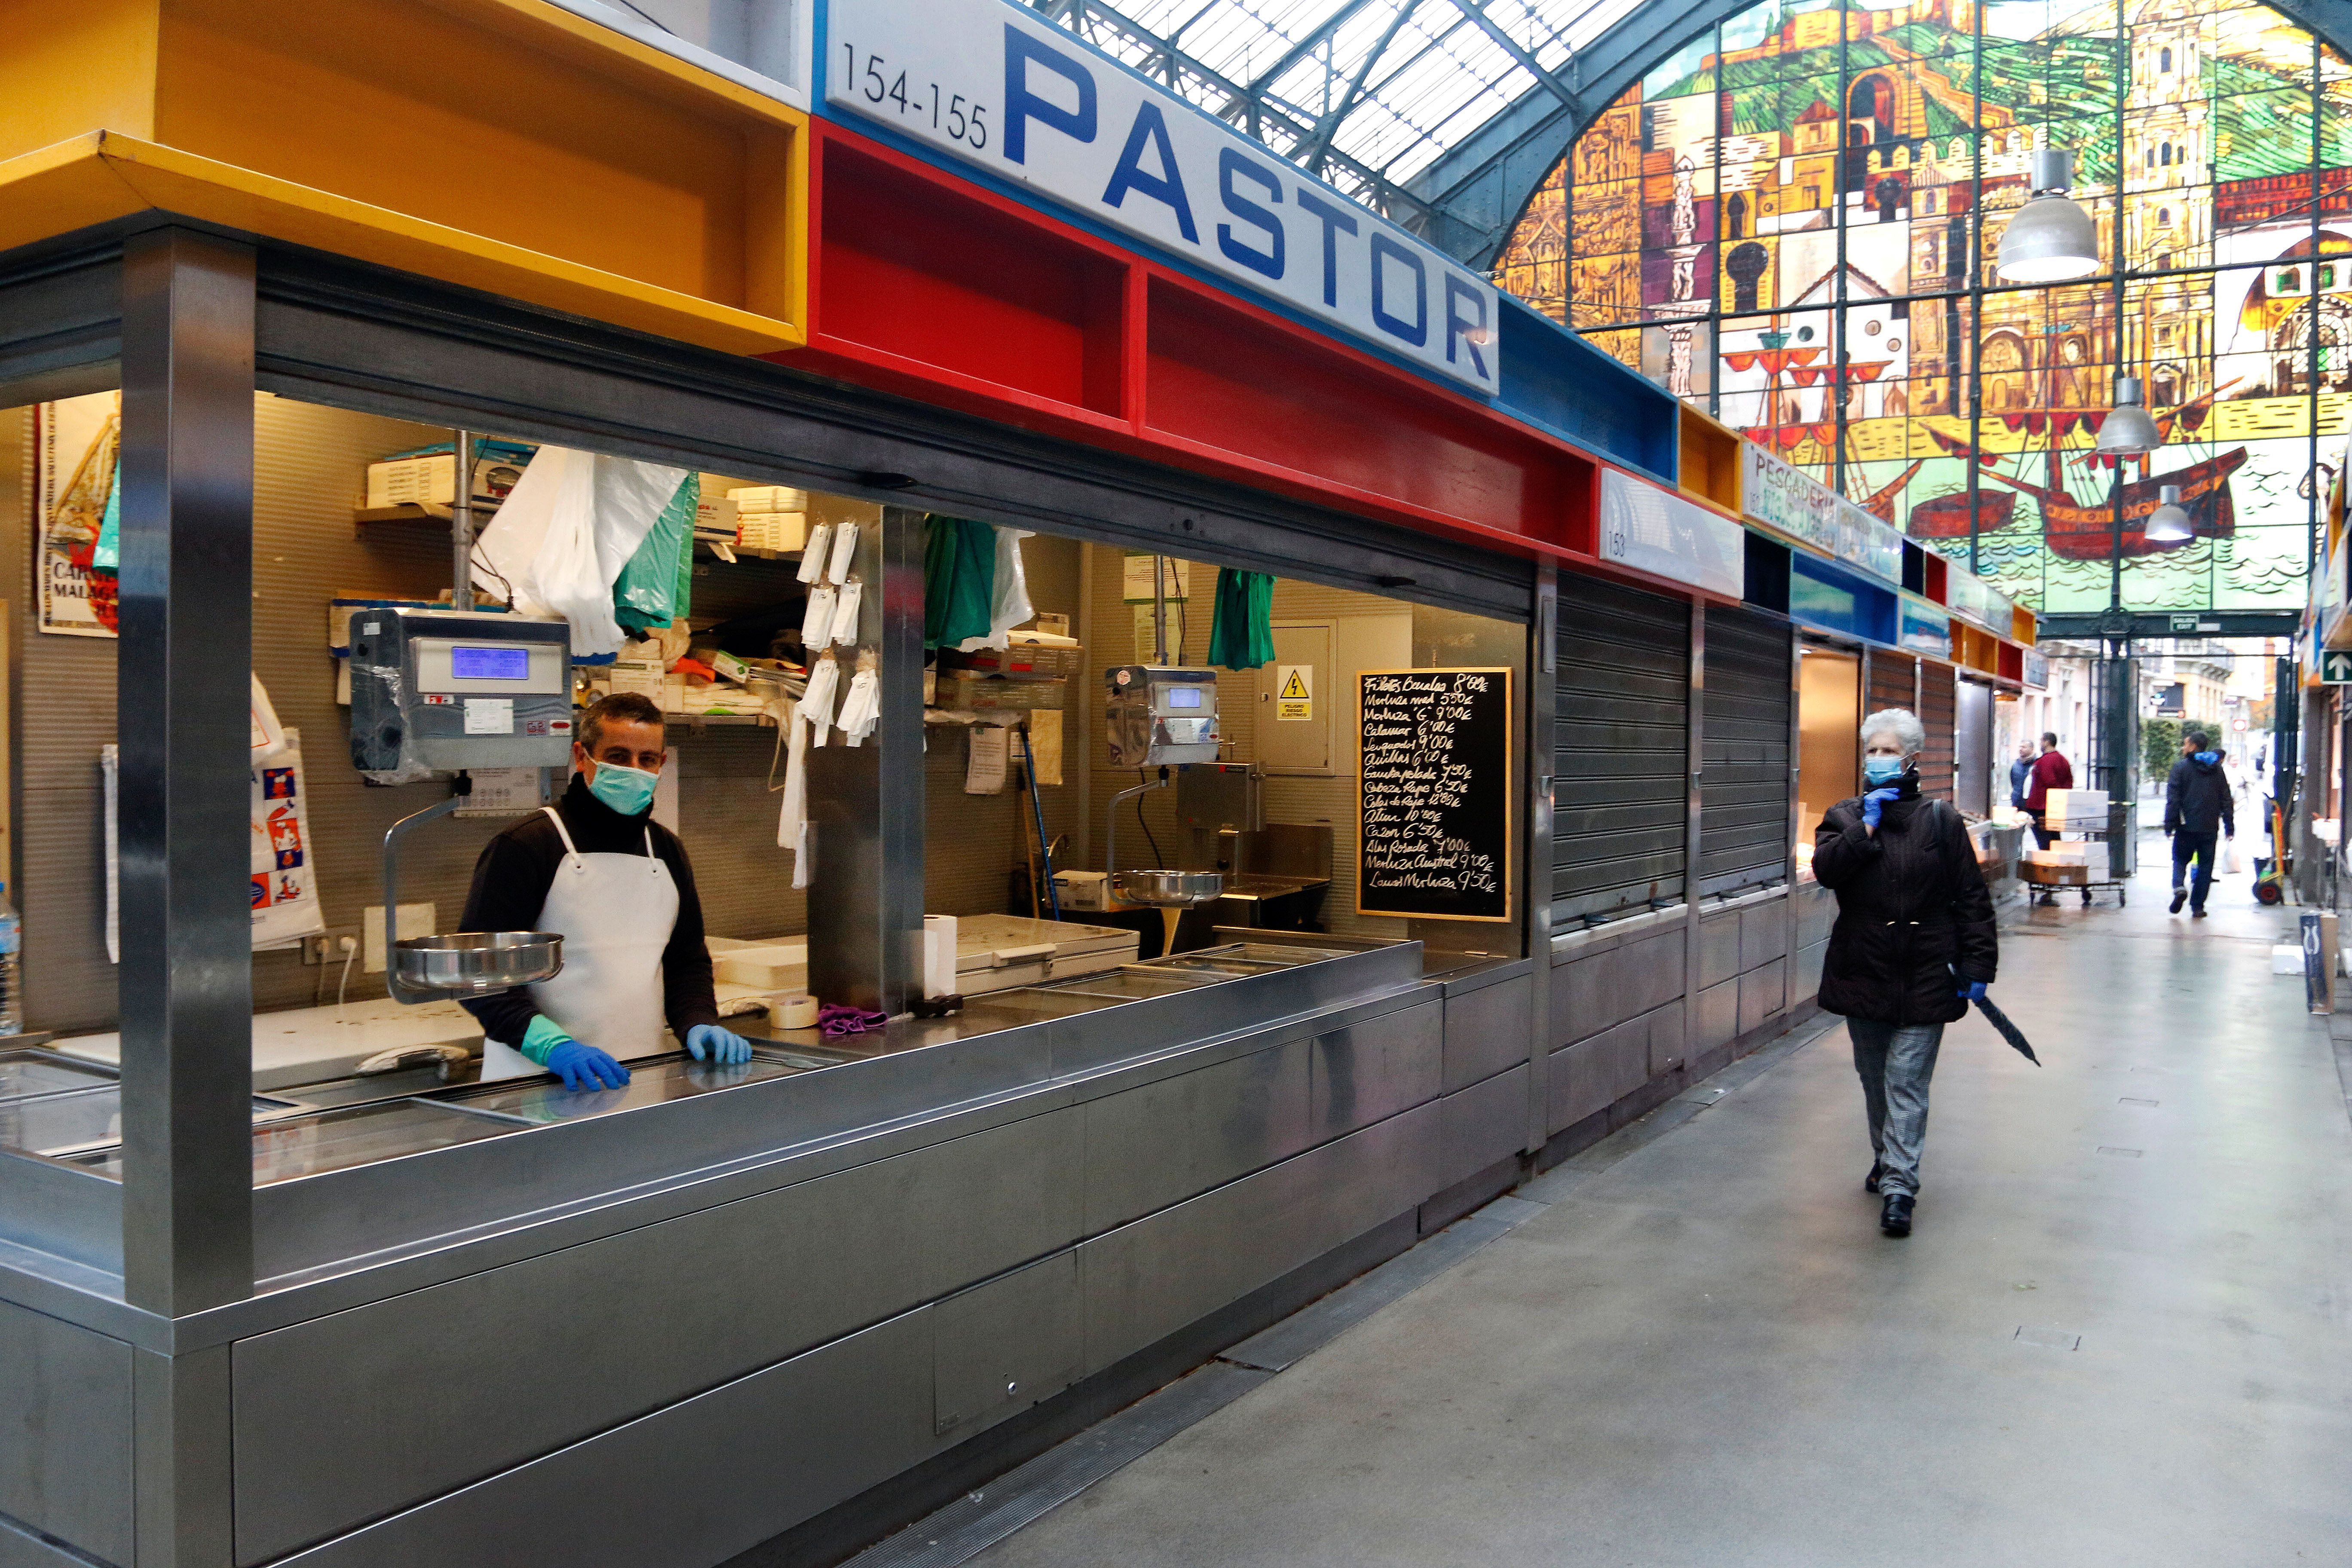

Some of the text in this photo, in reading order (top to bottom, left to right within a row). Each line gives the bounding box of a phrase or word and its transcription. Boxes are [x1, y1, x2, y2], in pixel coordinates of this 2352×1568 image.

[844, 42, 986, 149] 154-155
[1003, 21, 1490, 381] PASTOR
[1608, 531, 1625, 557] 153
